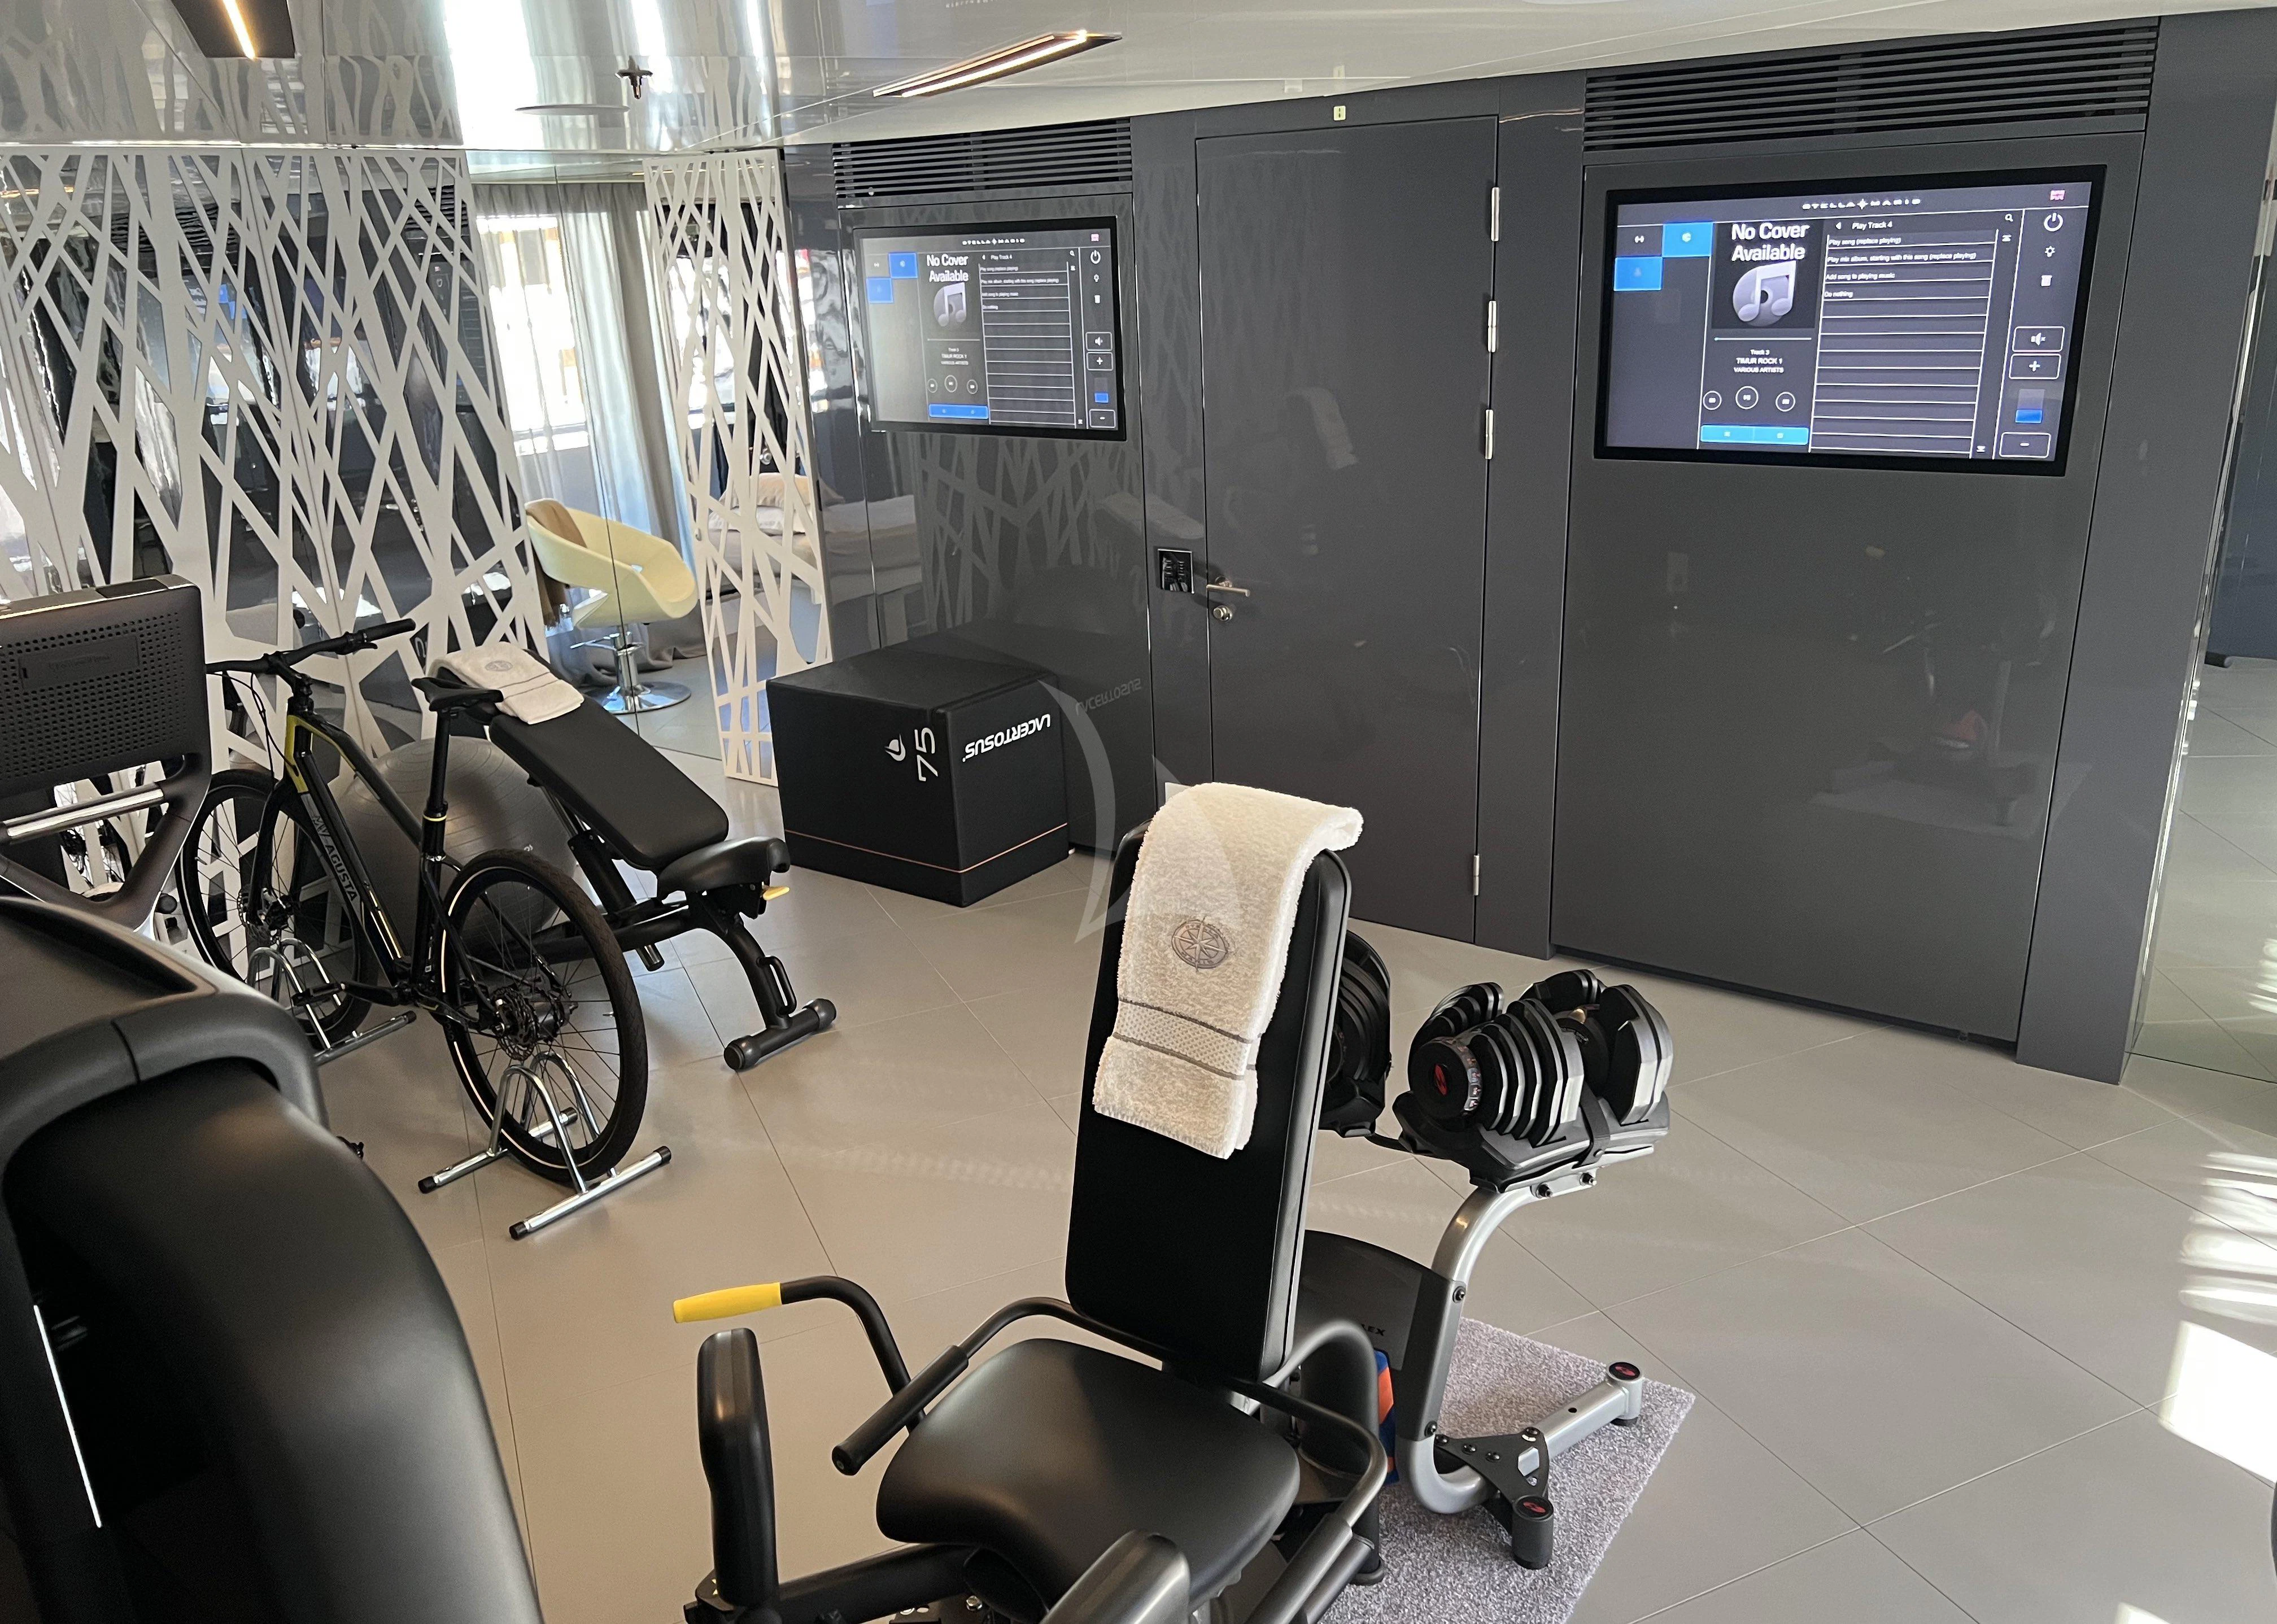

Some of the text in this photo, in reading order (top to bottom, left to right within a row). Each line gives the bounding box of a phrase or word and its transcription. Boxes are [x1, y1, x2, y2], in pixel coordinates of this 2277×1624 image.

[1731, 222, 1810, 240] No Cover
[926, 254, 969, 267] No Cover
[1731, 243, 1805, 261] Available
[929, 269, 969, 282] Available
[965, 713, 1051, 760] LACERTOSUS
[915, 727, 939, 782] 75
[325, 845, 358, 902] AGUSTA
